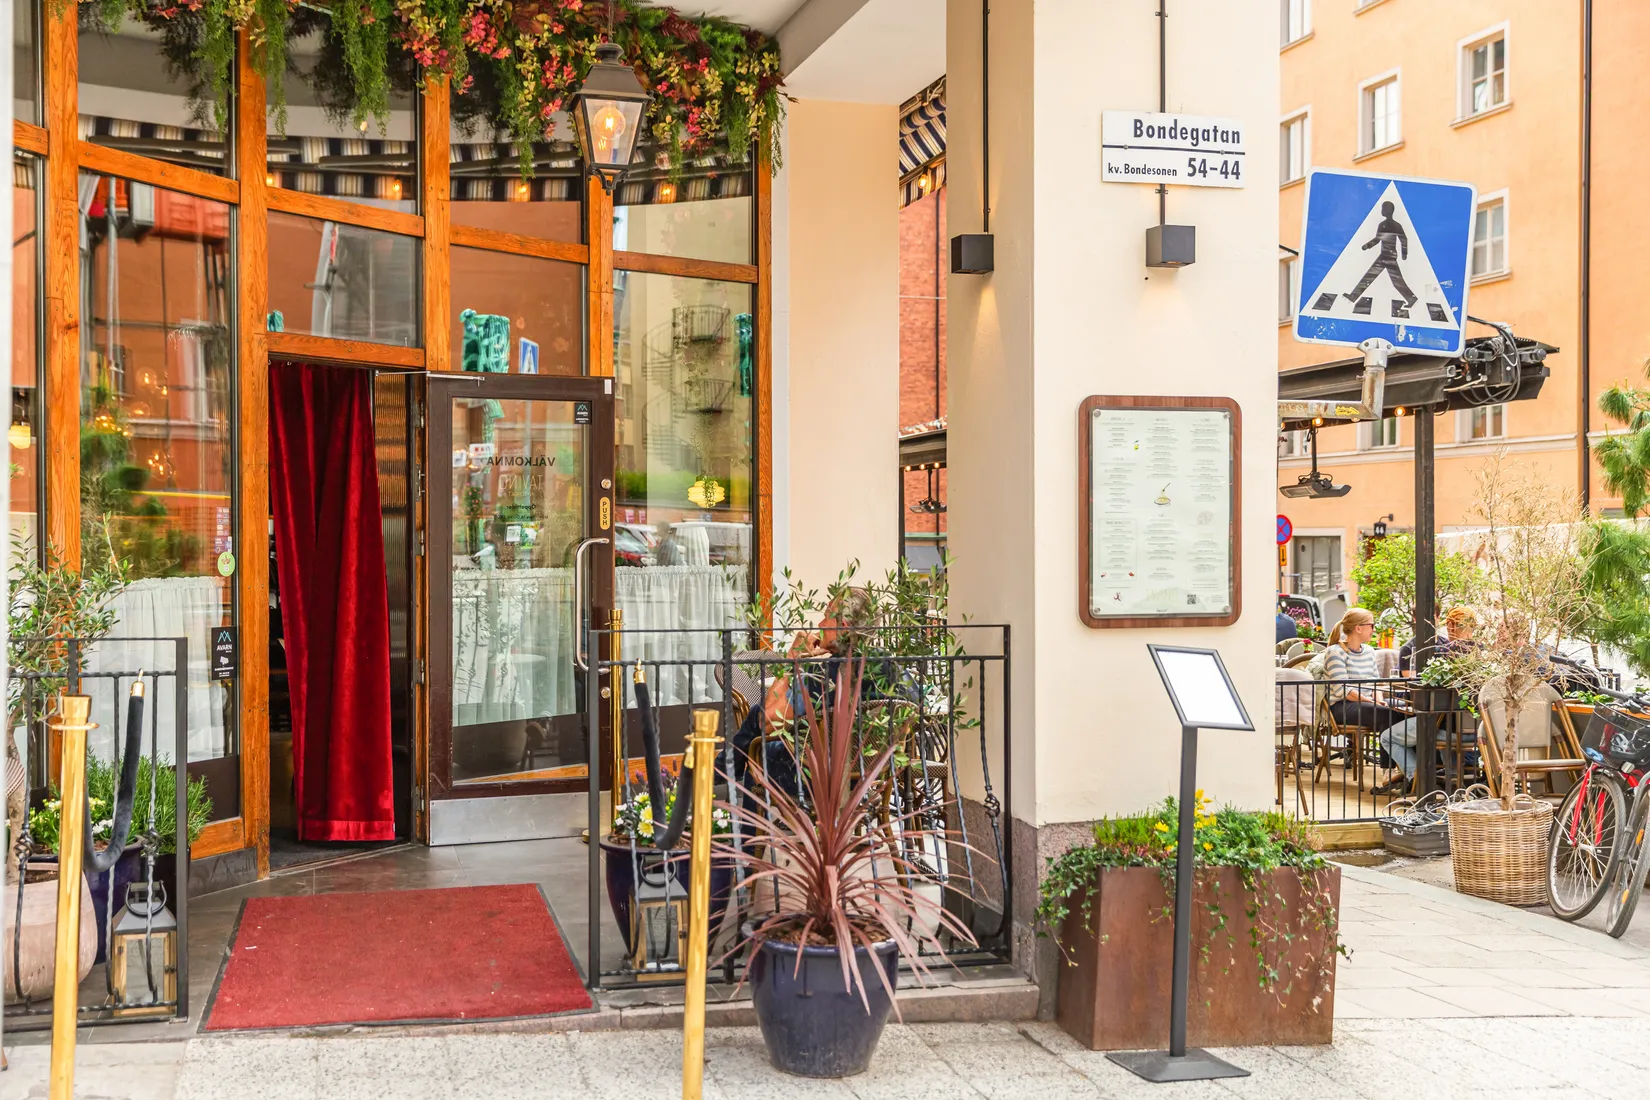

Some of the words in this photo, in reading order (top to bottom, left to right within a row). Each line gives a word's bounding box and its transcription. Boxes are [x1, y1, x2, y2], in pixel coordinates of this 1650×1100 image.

[1133, 118, 1241, 146] Bondegatan
[1107, 162, 1122, 174] kv.
[1124, 163, 1178, 177] Bondesonen
[1187, 157, 1241, 180] 54-44
